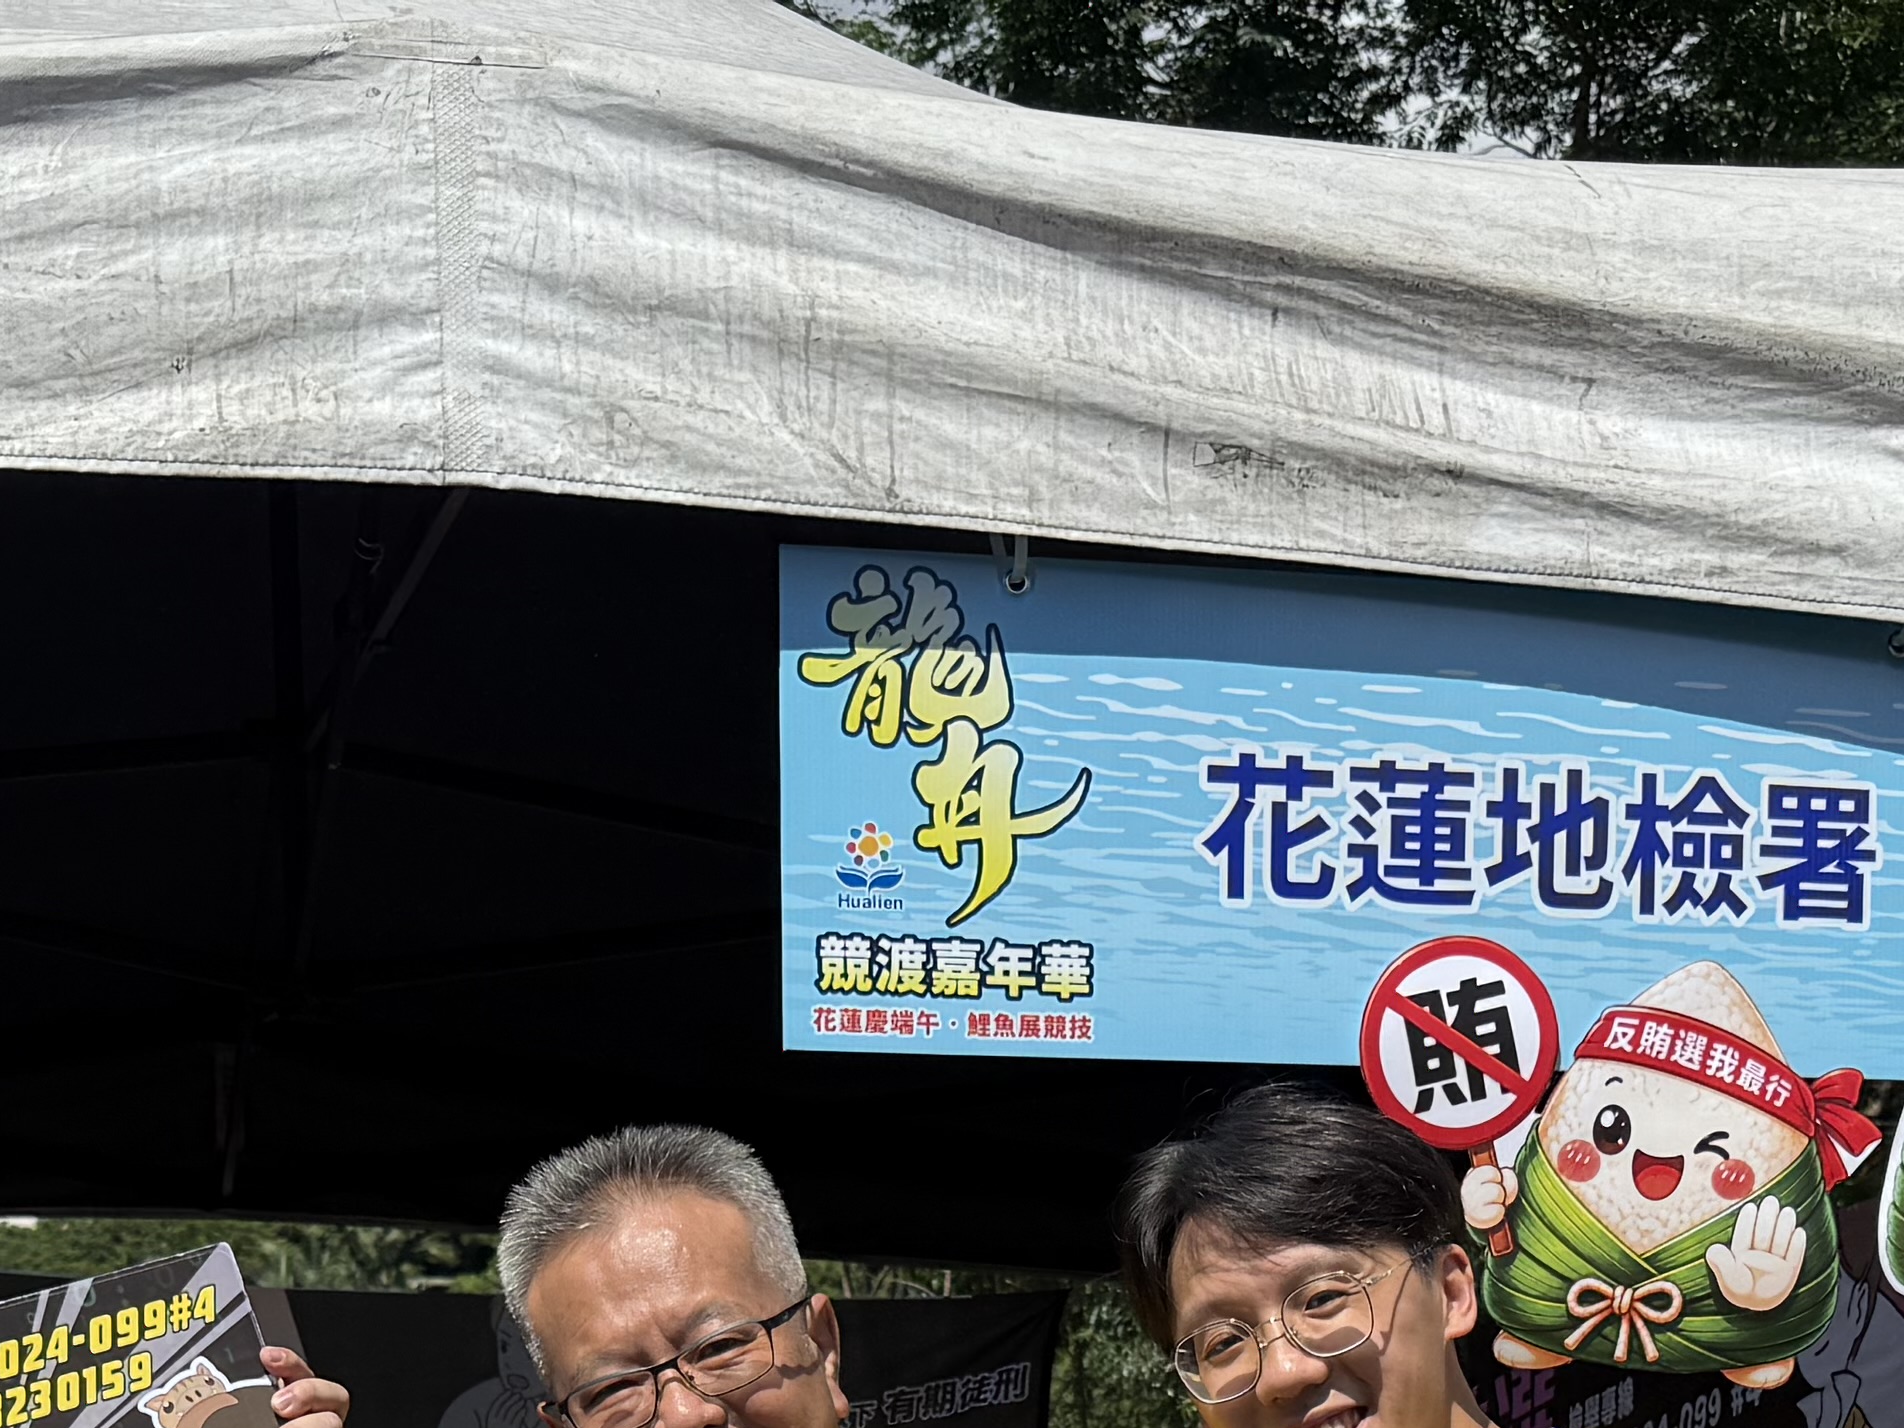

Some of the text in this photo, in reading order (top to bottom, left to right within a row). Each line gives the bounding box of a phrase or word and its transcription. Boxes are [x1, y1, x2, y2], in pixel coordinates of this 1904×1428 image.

[1200, 752, 1880, 927] 花蓮地檢署
[837, 893, 903, 910] Hualien
[816, 931, 1094, 1003] 競渡嘉年華
[1404, 977, 1520, 1113] 賄
[1603, 1015, 1793, 1107] 反賄選我最行
[883, 1361, 1030, 1427] 有期徒刑
